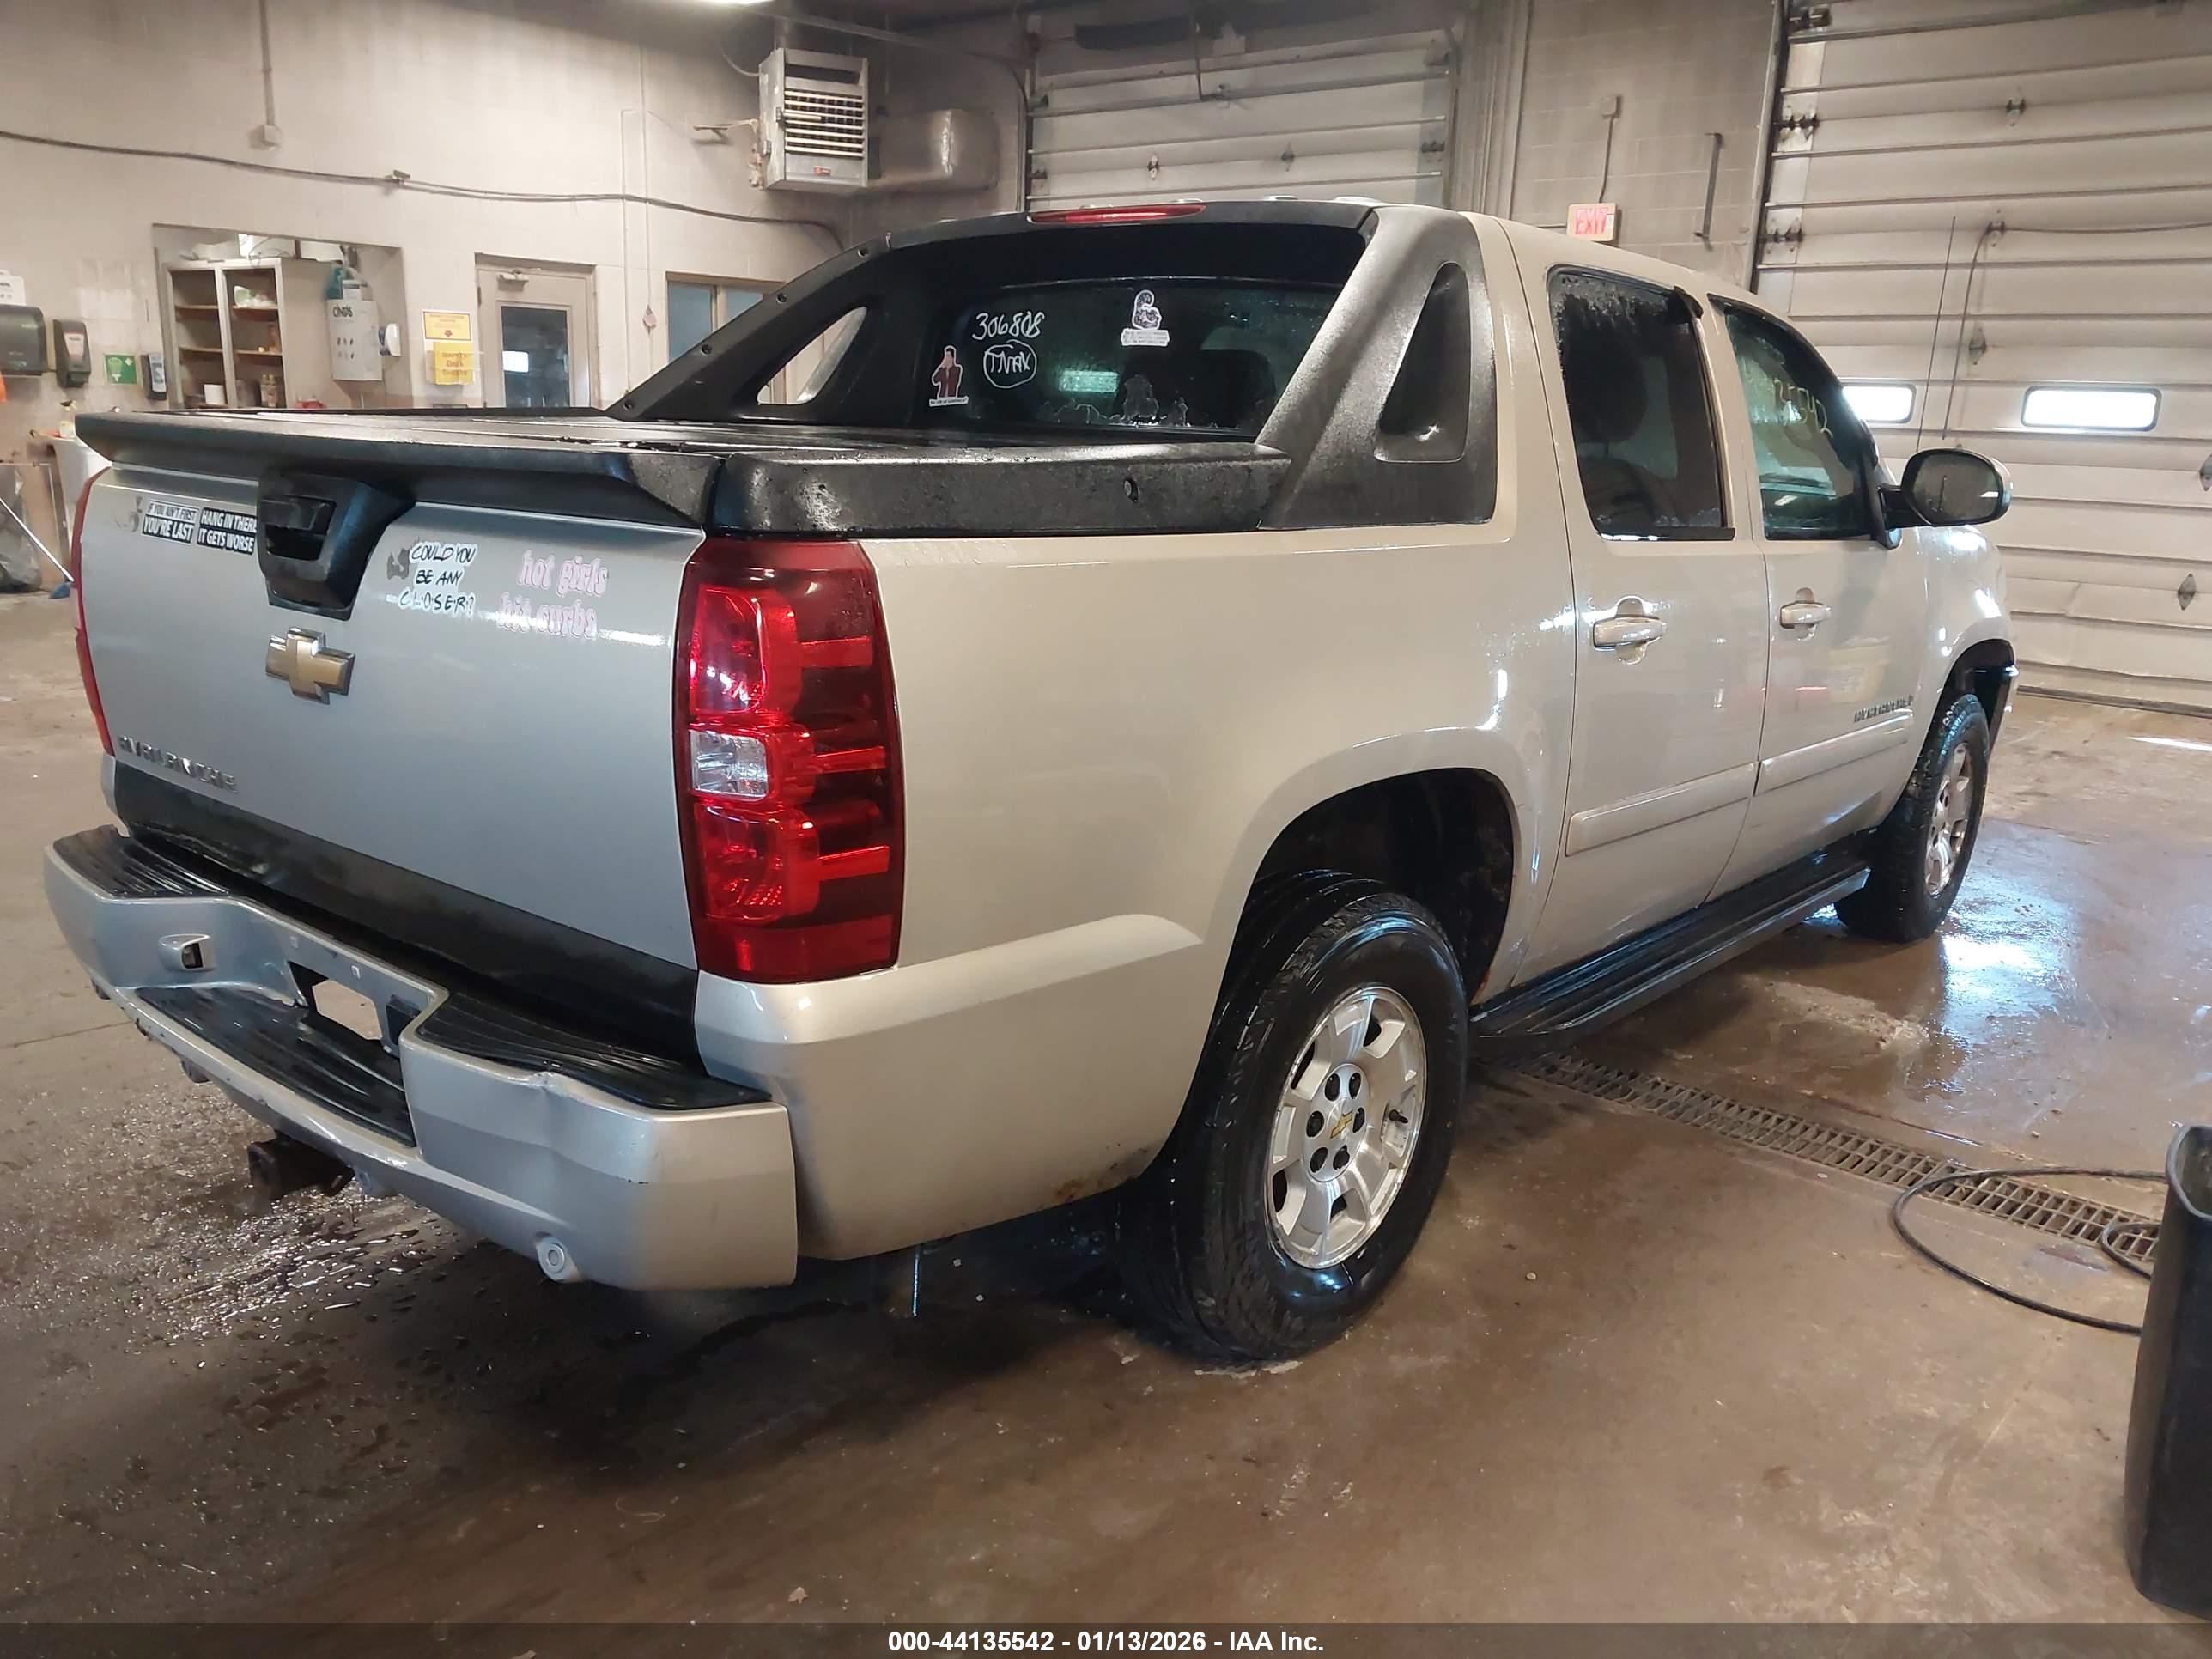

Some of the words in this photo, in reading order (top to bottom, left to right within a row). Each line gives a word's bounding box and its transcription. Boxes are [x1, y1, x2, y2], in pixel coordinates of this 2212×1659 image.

[1576, 207, 1607, 234] EXIT
[972, 311, 1045, 340] 306808
[143, 515, 173, 538] YOU'RE
[172, 522, 194, 541] LAST
[201, 509, 224, 526] HANG
[223, 514, 234, 529] IN
[198, 528, 207, 543] IT
[207, 531, 226, 547] GETS
[226, 534, 255, 552] WORSE
[411, 544, 453, 561] COULD
[455, 547, 477, 563] YOU
[416, 569, 434, 584] BE
[435, 570, 463, 586] ANY
[518, 550, 556, 590] hot
[556, 556, 609, 598] girls
